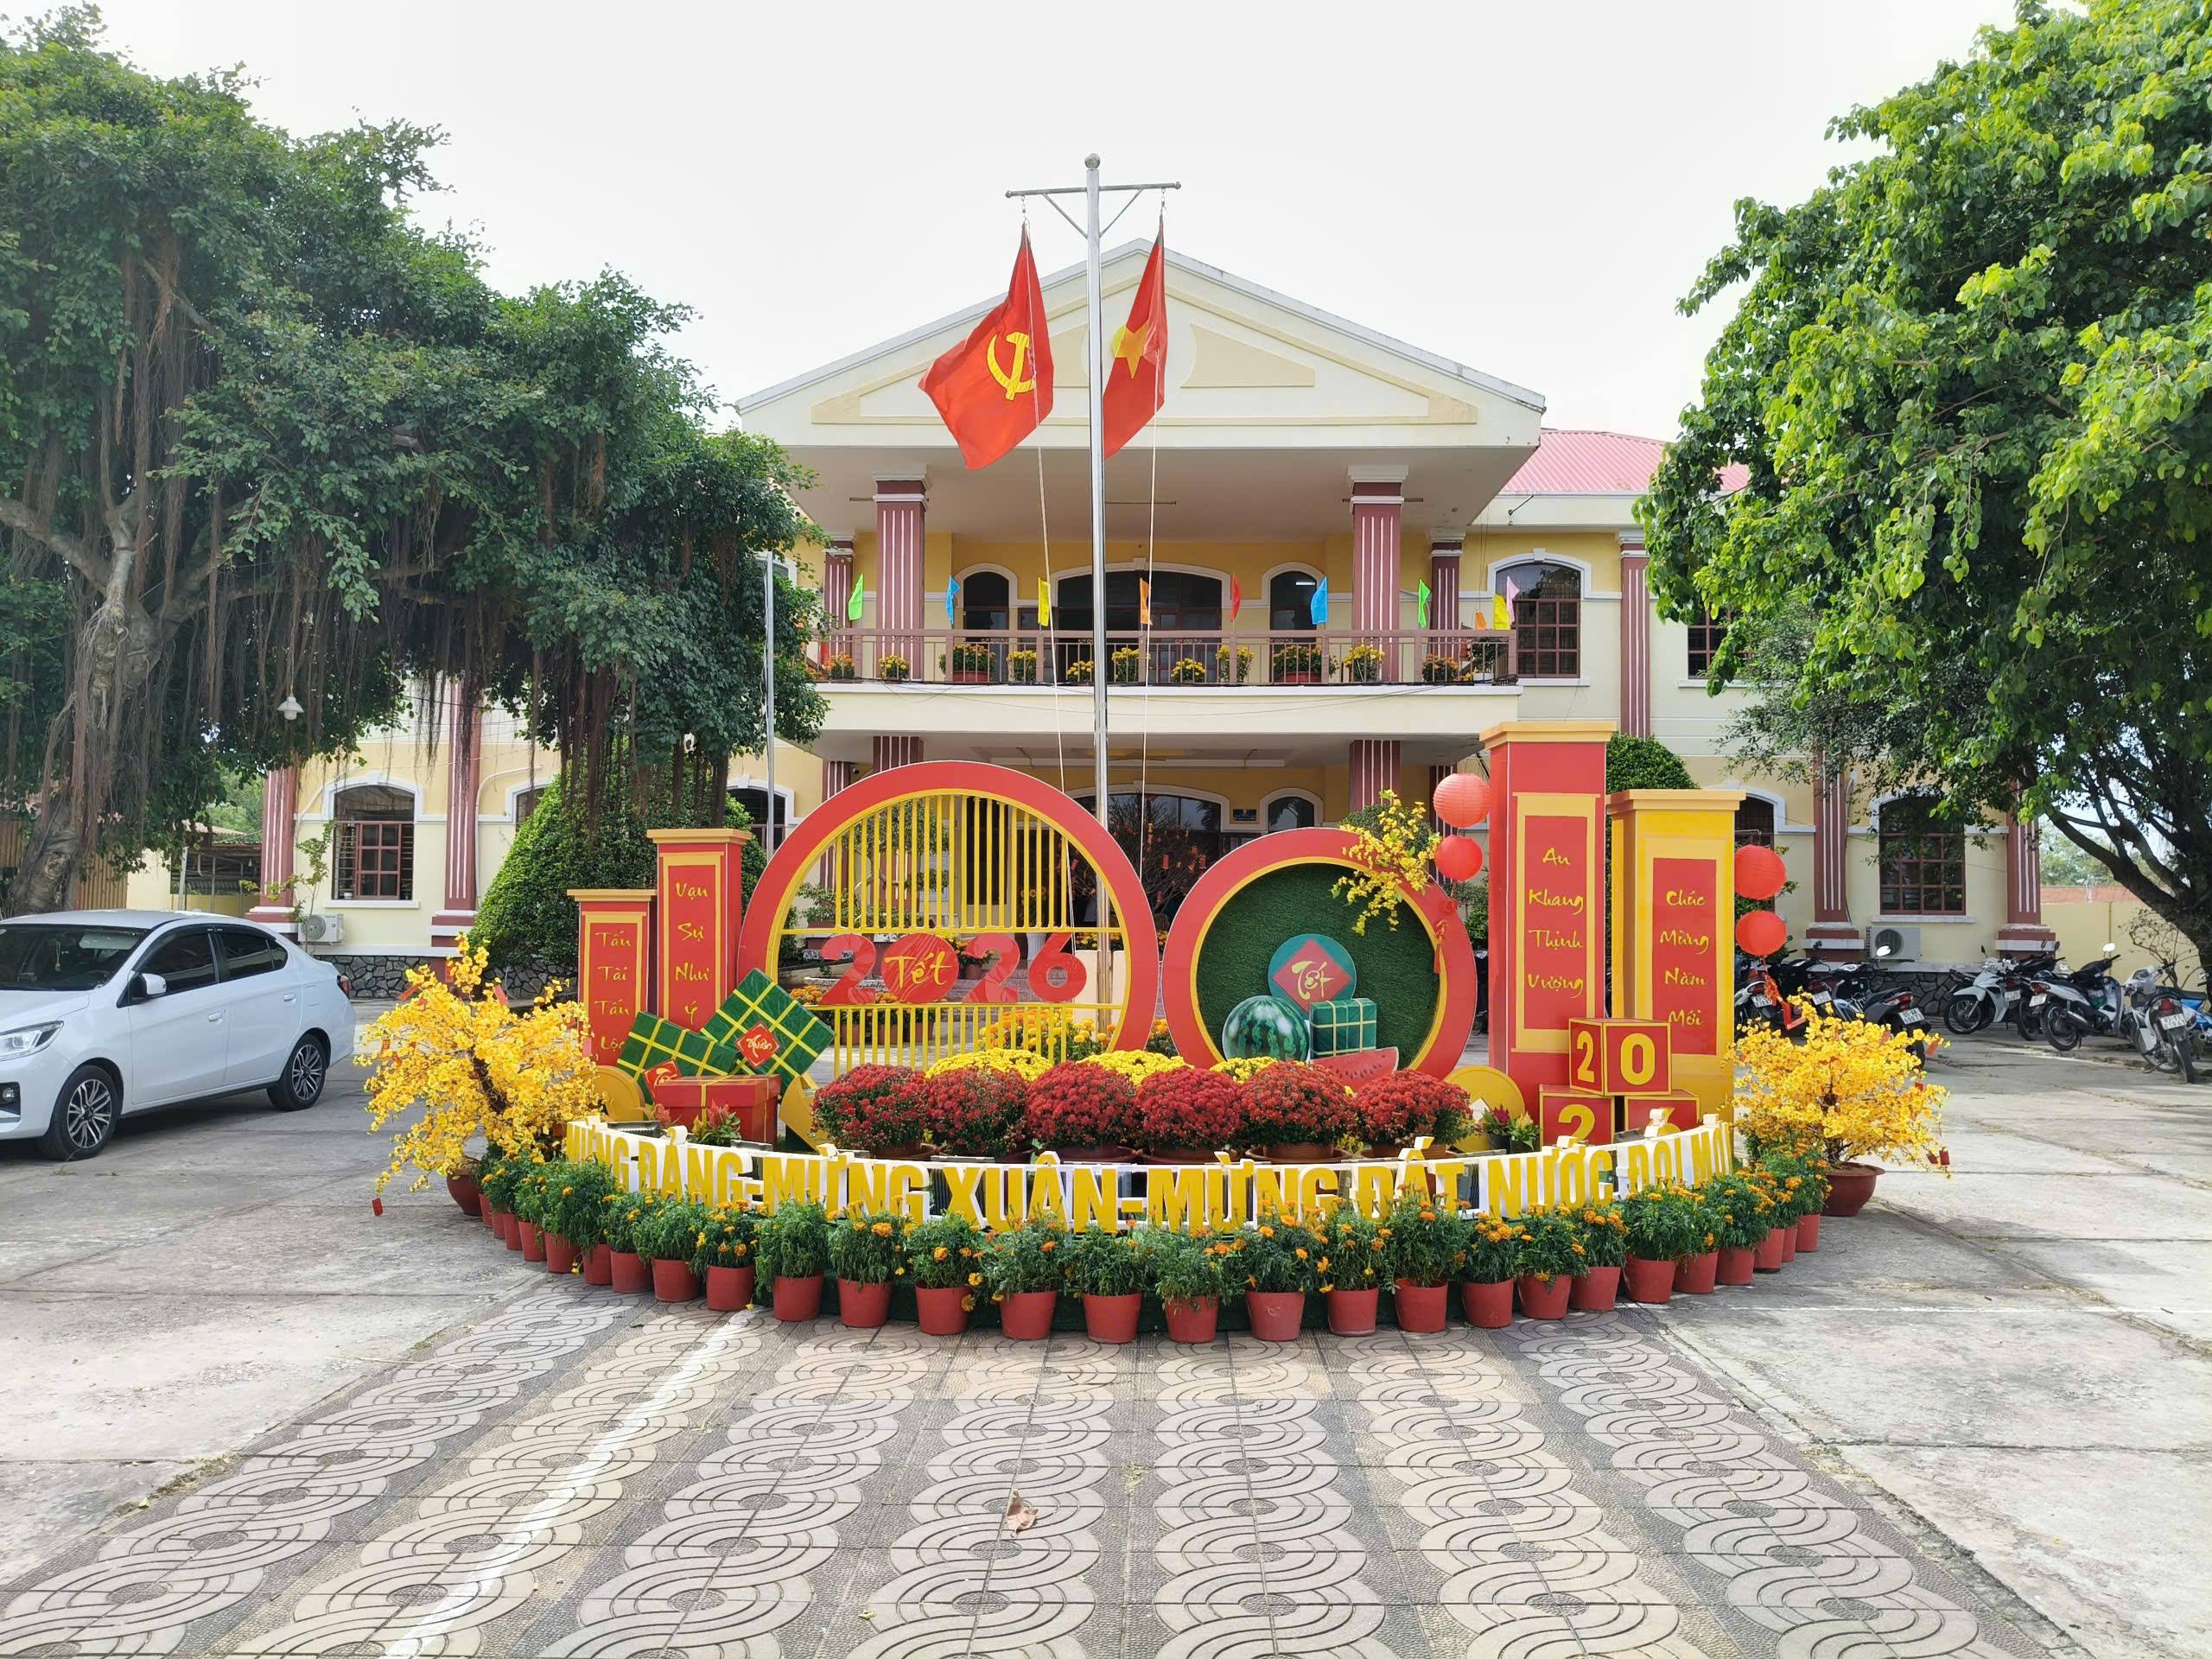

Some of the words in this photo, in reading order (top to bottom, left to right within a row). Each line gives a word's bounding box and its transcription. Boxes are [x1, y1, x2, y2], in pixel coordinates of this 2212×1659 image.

[1542, 848, 1571, 866] An
[676, 882, 709, 899] Vạn
[1666, 889, 1706, 906] Chúc
[1529, 888, 1584, 915] Khang
[595, 931, 632, 948] Tấn
[677, 923, 704, 942] Sự
[1528, 930, 1584, 950] Thịnh
[1660, 930, 1709, 955] Mừng
[597, 965, 628, 981] Tài
[676, 962, 709, 982] Như
[884, 950, 953, 988] Tết
[1291, 960, 1334, 1001] Tết
[1528, 974, 1584, 999] Vượng
[594, 999, 630, 1016] Tấn
[1668, 1009, 1702, 1027] Mới
[746, 1033, 773, 1058] Xuân
[1354, 1135, 1465, 1223] ĐẤT
[1487, 1135, 1614, 1221] NƯỚC
